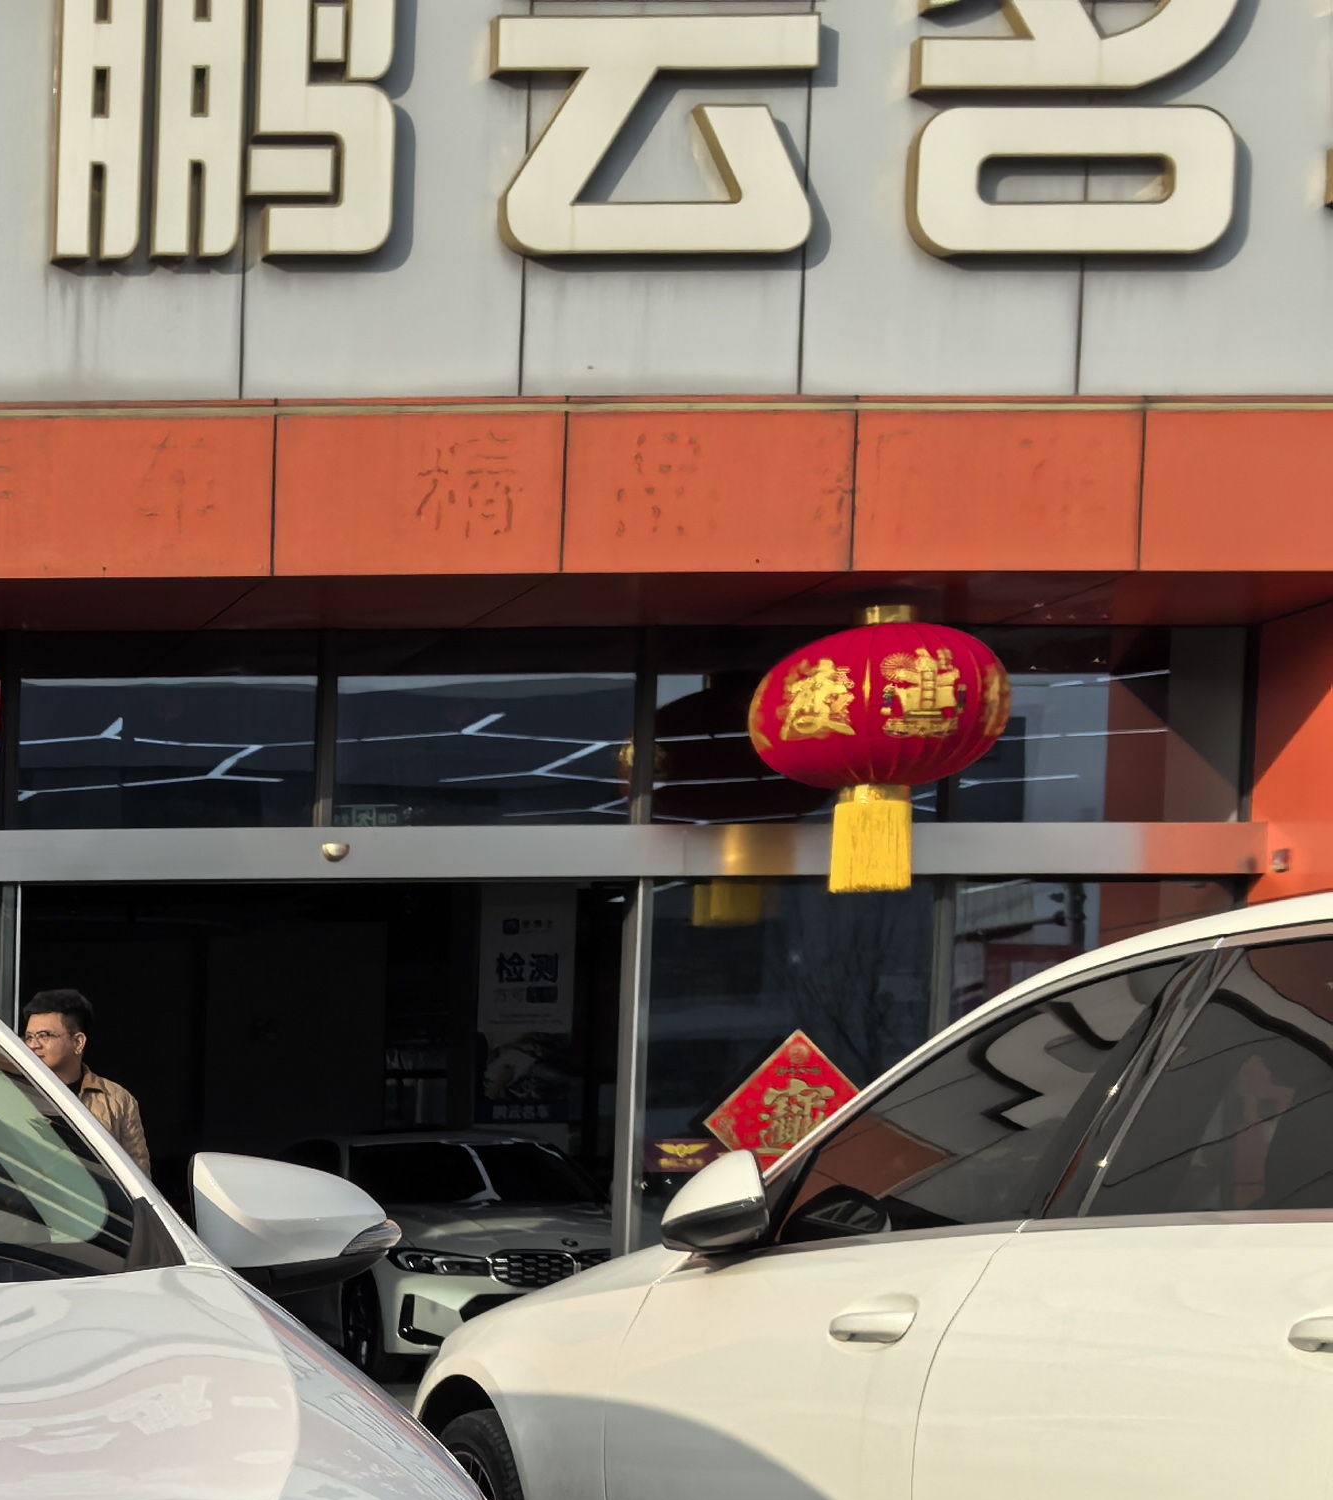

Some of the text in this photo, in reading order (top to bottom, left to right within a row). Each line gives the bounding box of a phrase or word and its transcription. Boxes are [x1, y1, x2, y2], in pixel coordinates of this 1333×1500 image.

[51, 0, 1333, 260] 鹏云名
[495, 952, 559, 983] 检测
